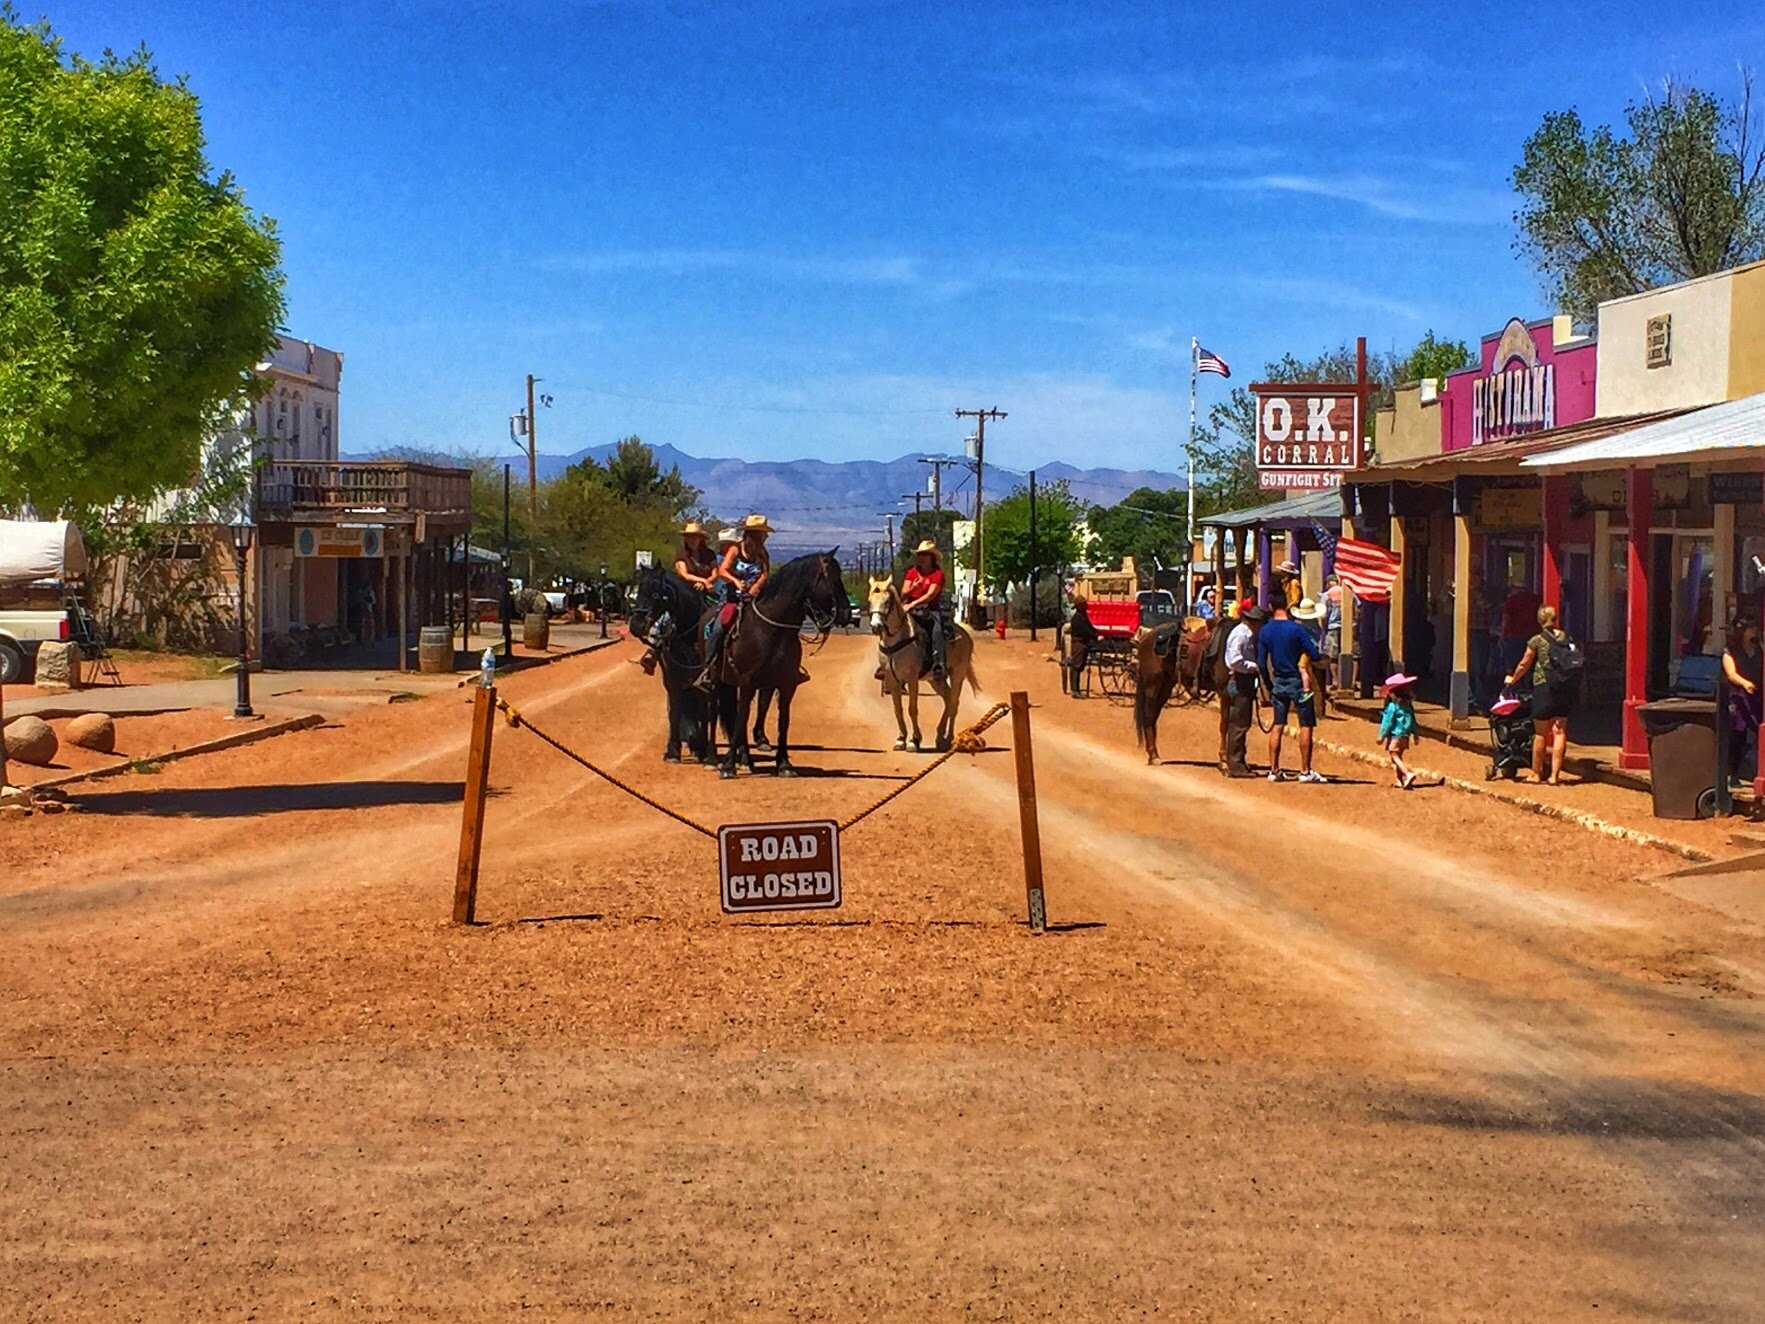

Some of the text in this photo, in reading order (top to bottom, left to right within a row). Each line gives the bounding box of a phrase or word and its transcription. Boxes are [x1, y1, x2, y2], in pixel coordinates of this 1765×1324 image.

[1472, 364, 1554, 445] HISTORAMA
[1262, 397, 1349, 441] O.K.
[1262, 445, 1349, 464] CORRAL
[1261, 472, 1345, 487] GUNFIGHT SIT
[740, 834, 818, 862] ROAD
[730, 871, 832, 900] CLOSED
